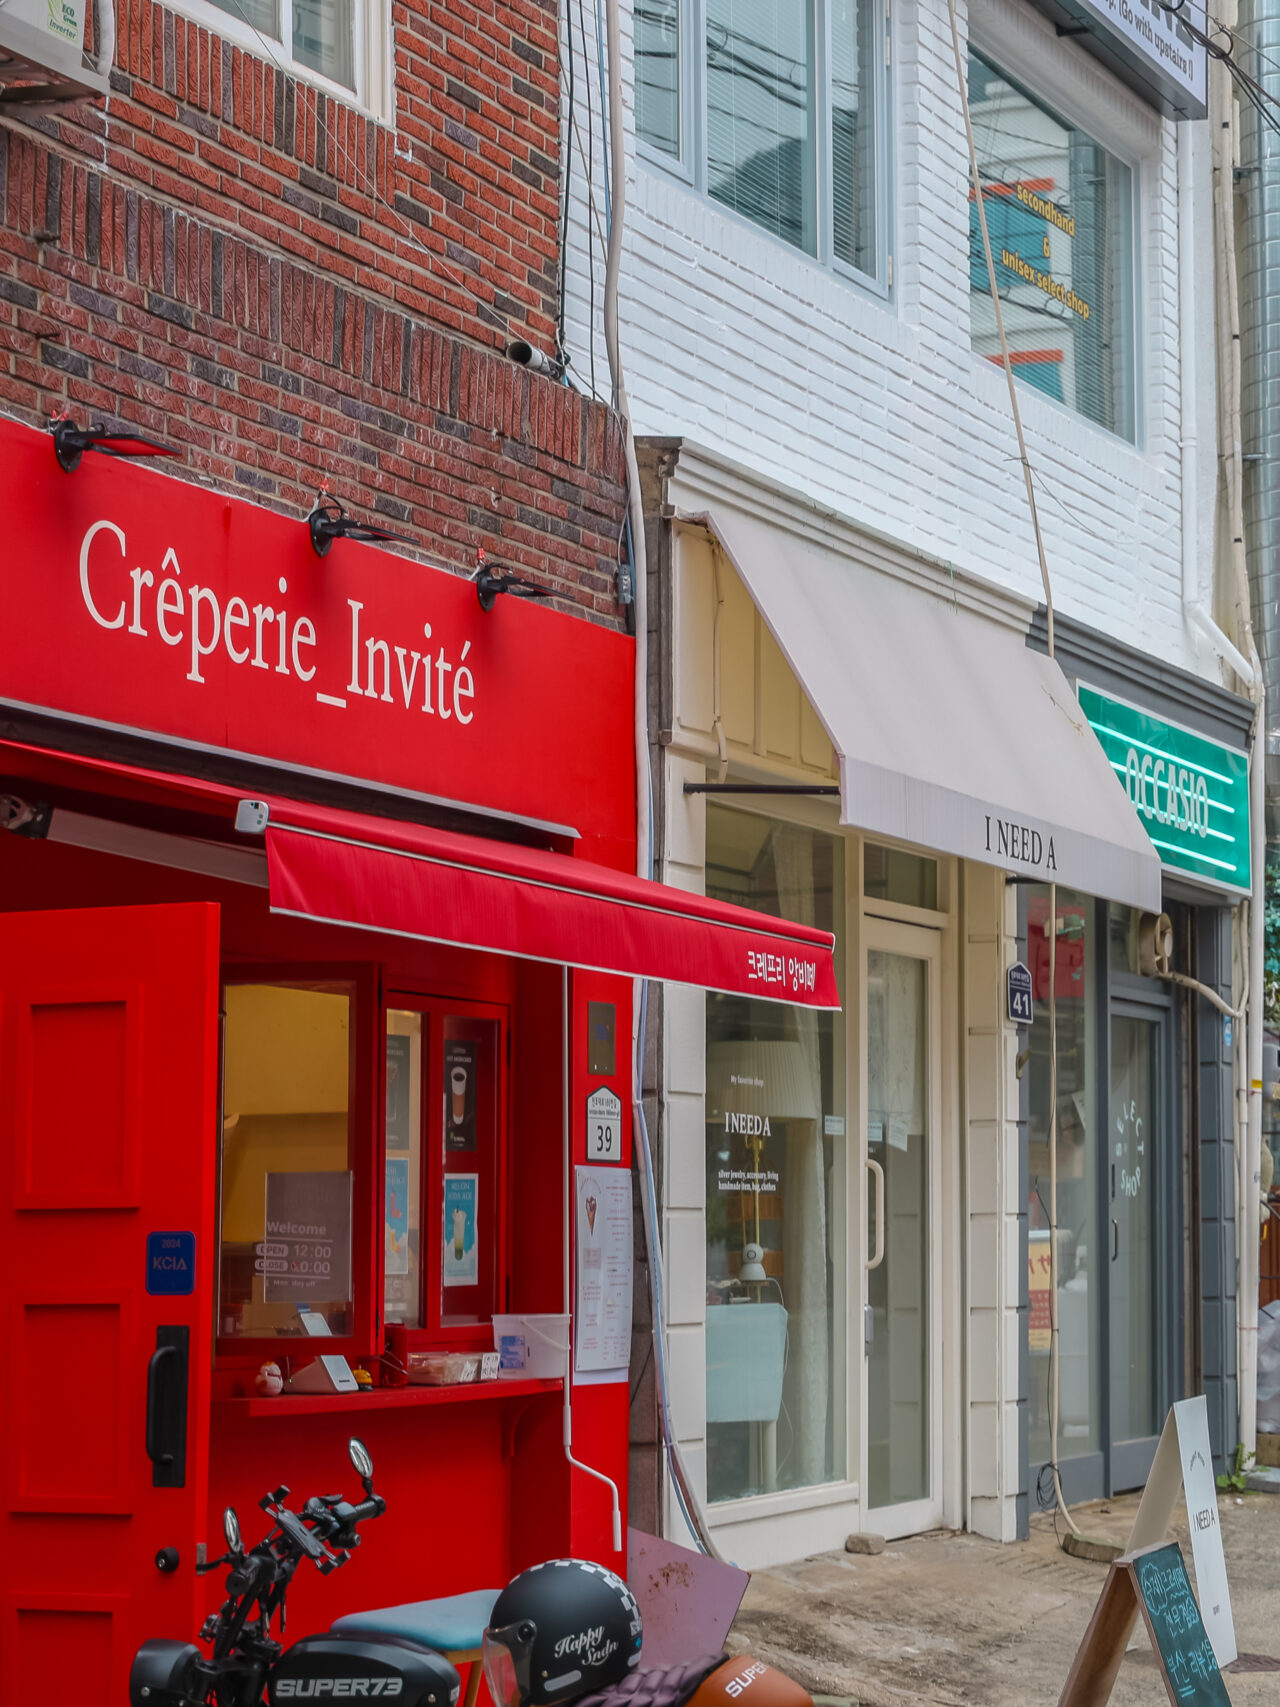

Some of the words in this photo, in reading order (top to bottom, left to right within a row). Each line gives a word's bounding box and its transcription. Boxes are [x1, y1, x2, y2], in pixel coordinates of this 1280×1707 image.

[62, 4, 75, 18] ECO
[49, 19, 76, 39] Inverter
[1134, 14, 1153, 43] with
[1154, 33, 1187, 74] upstairs
[1017, 184, 1075, 237] secondhand
[1042, 236, 1050, 258] &
[1002, 248, 1035, 283] unisex
[1037, 272, 1065, 303] select
[1066, 289, 1090, 321] shop
[1126, 747, 1209, 839] OCCASIO
[985, 815, 991, 852] I
[997, 819, 1042, 865] NEED
[1046, 835, 1057, 871] A
[747, 950, 786, 987] 크레프리
[788, 956, 816, 993] 앙비떼
[1013, 992, 1029, 1016] 41
[730, 1074, 737, 1086] My
[754, 1077, 764, 1089] shop
[596, 1125, 612, 1153] 39
[718, 1180, 740, 1191] handmade
[267, 1221, 327, 1235] Welcome
[294, 1244, 332, 1258] 12:00
[1197, 1510, 1210, 1531] NEED
[554, 1625, 606, 1659] Happy
[275, 1677, 403, 1698] SUPER73
